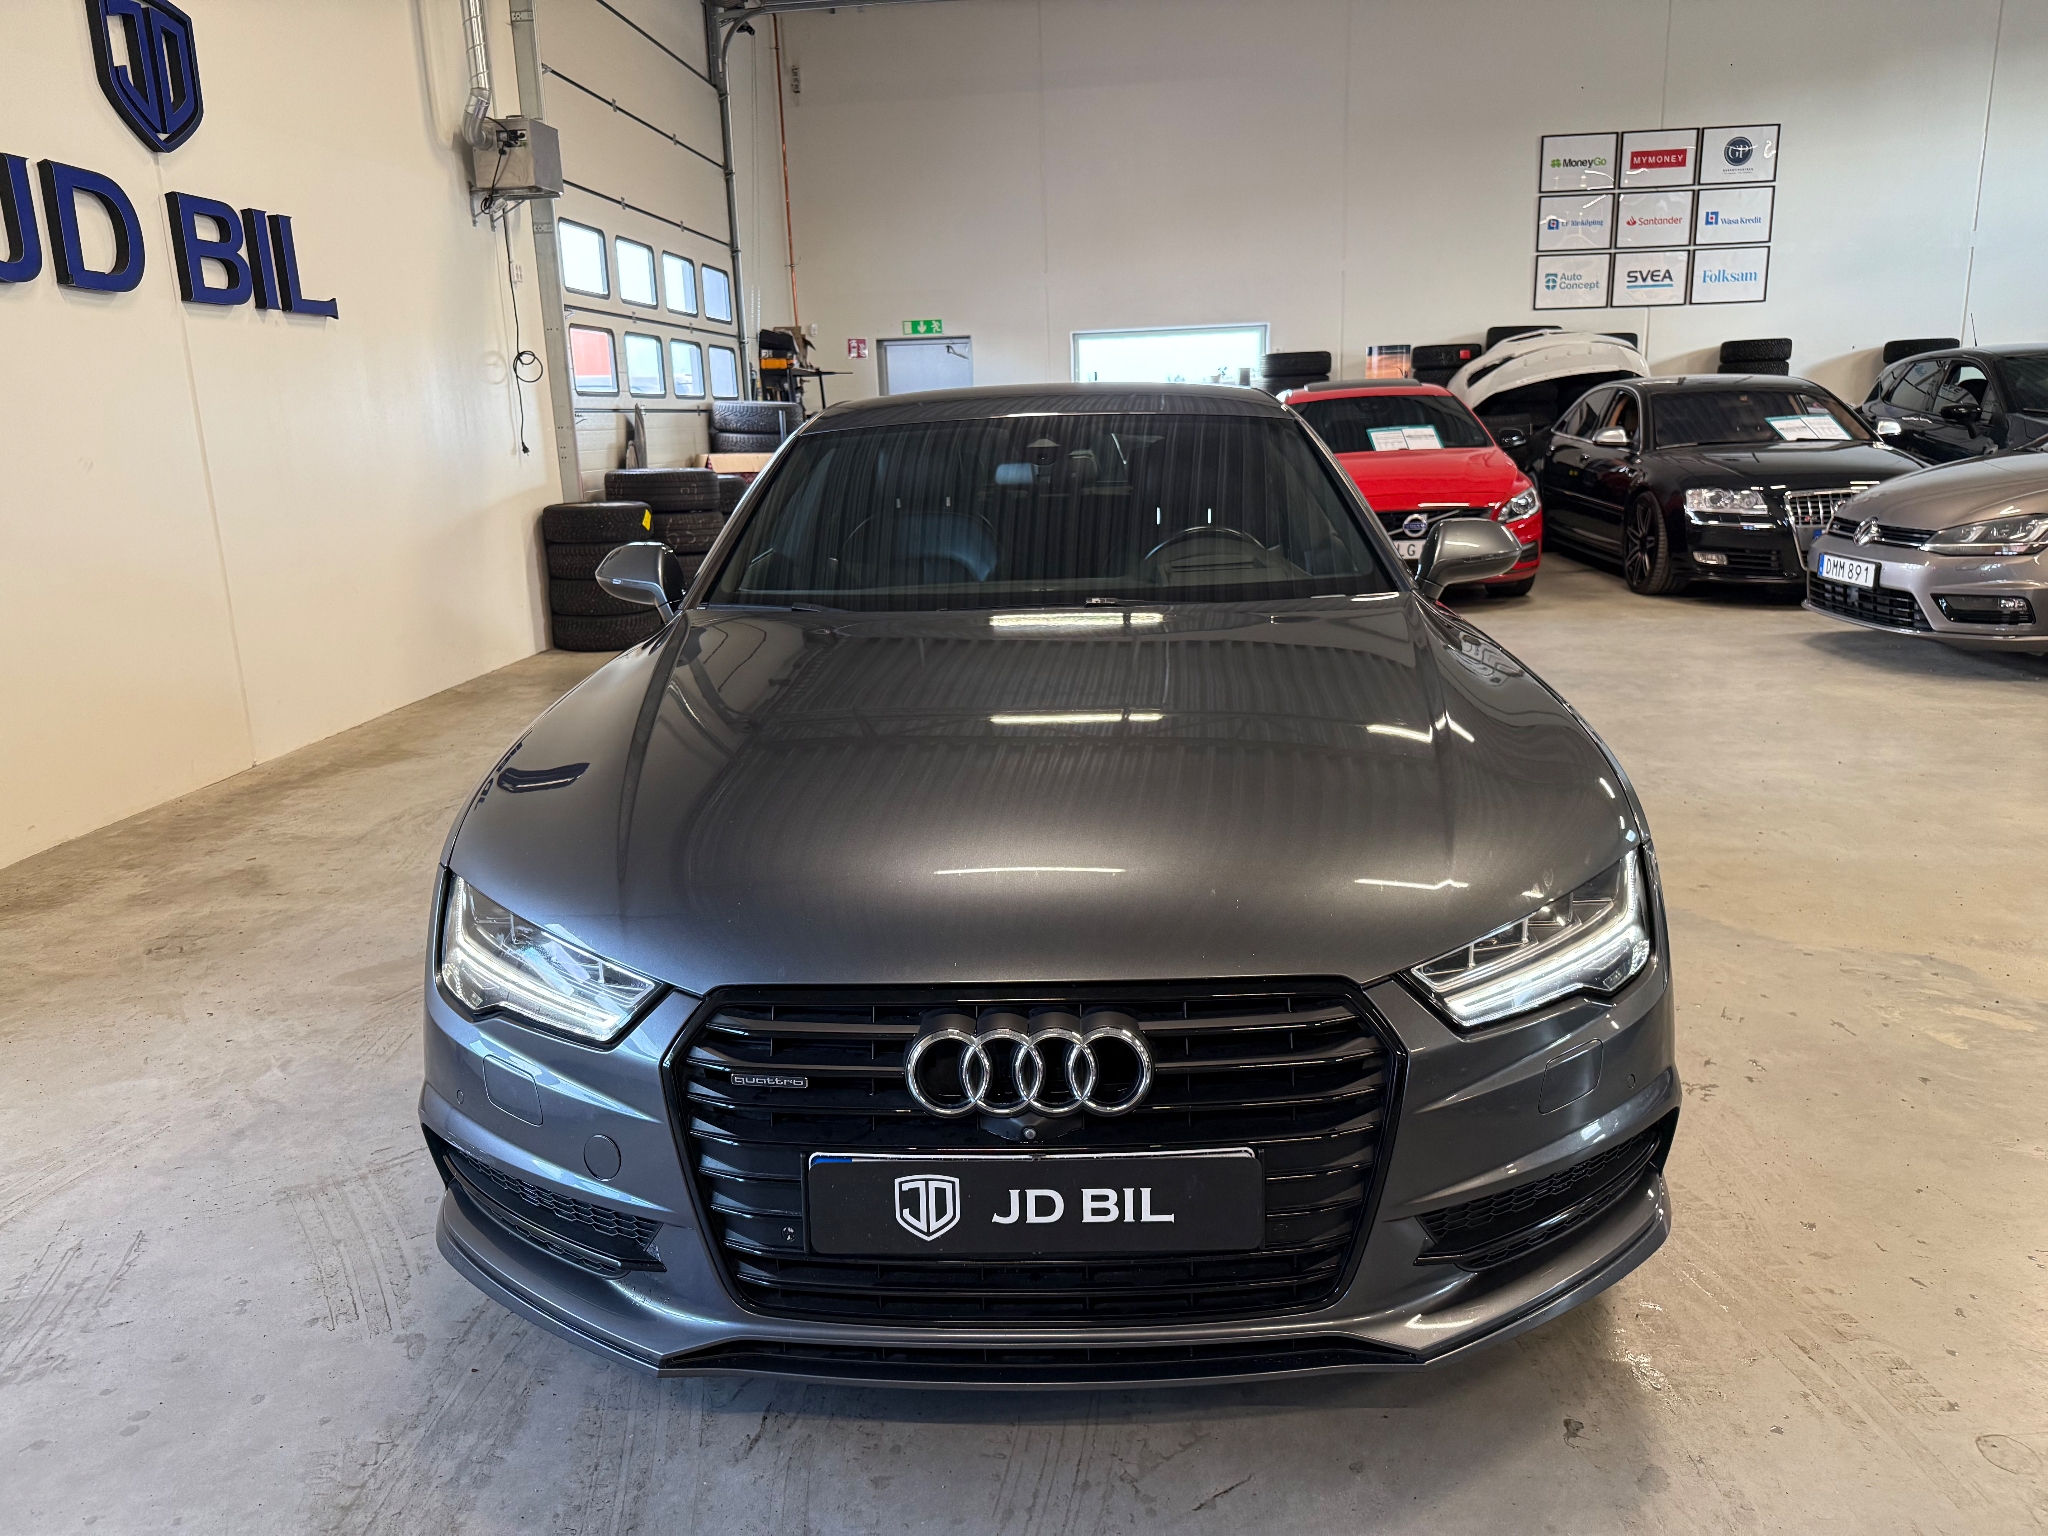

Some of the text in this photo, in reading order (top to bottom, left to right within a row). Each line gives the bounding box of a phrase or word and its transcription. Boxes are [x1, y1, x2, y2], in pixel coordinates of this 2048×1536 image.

[1562, 157, 1607, 169] MoneyGo
[1633, 154, 1684, 164] MYMONEY
[1638, 216, 1683, 226] Santander
[1721, 216, 1761, 225] Wasa Kredit
[165, 191, 339, 319] BIL
[1560, 272, 1582, 281] Auto
[1626, 269, 1674, 283] SVEA
[1702, 269, 1758, 284] Folksam
[1559, 280, 1600, 290] Concept
[1825, 558, 1869, 583] DMM 891
[734, 1076, 804, 1086] quattro
[991, 1188, 1065, 1224] JD
[1081, 1187, 1175, 1224] BIL
